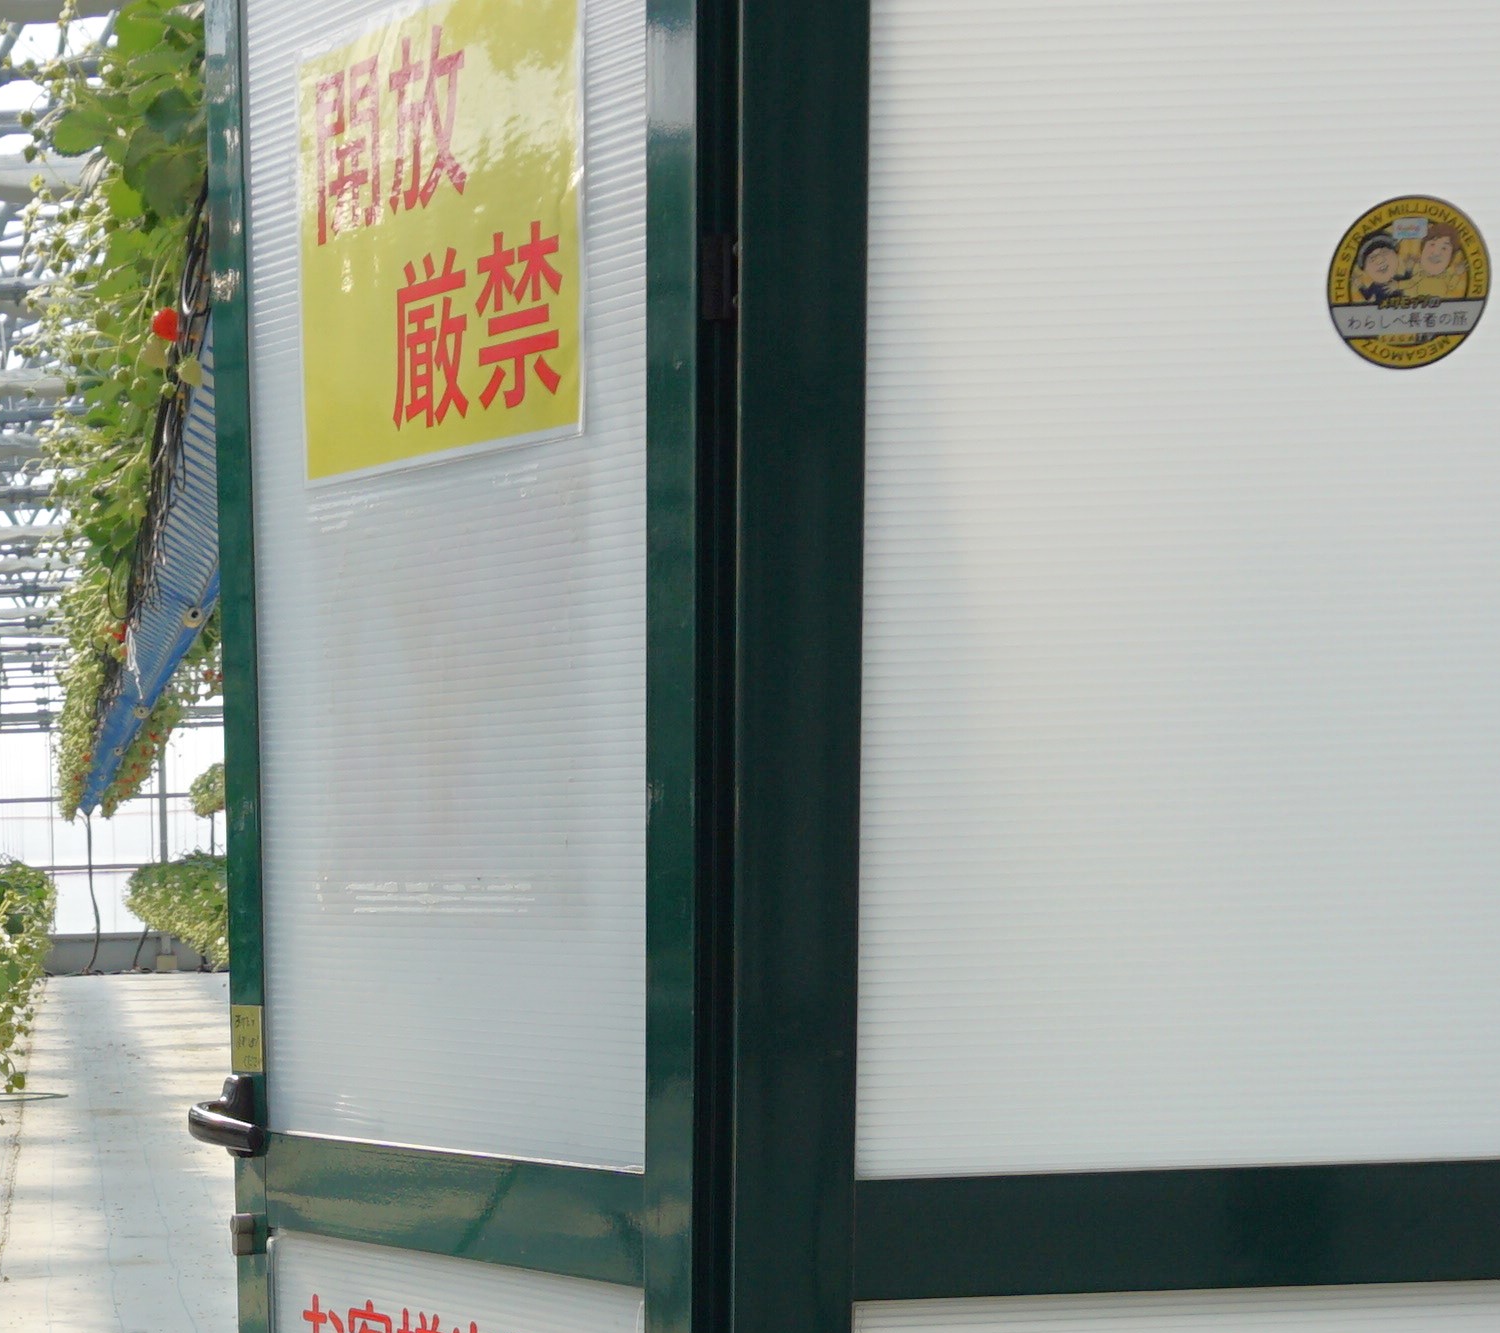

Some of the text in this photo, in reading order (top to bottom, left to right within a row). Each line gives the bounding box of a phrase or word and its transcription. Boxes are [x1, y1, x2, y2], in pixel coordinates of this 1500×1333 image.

[315, 24, 467, 246] 開放
[392, 220, 563, 431] 厳禁
[1334, 202, 1485, 301] THE STRAW MILLIONAIRE TOUR
